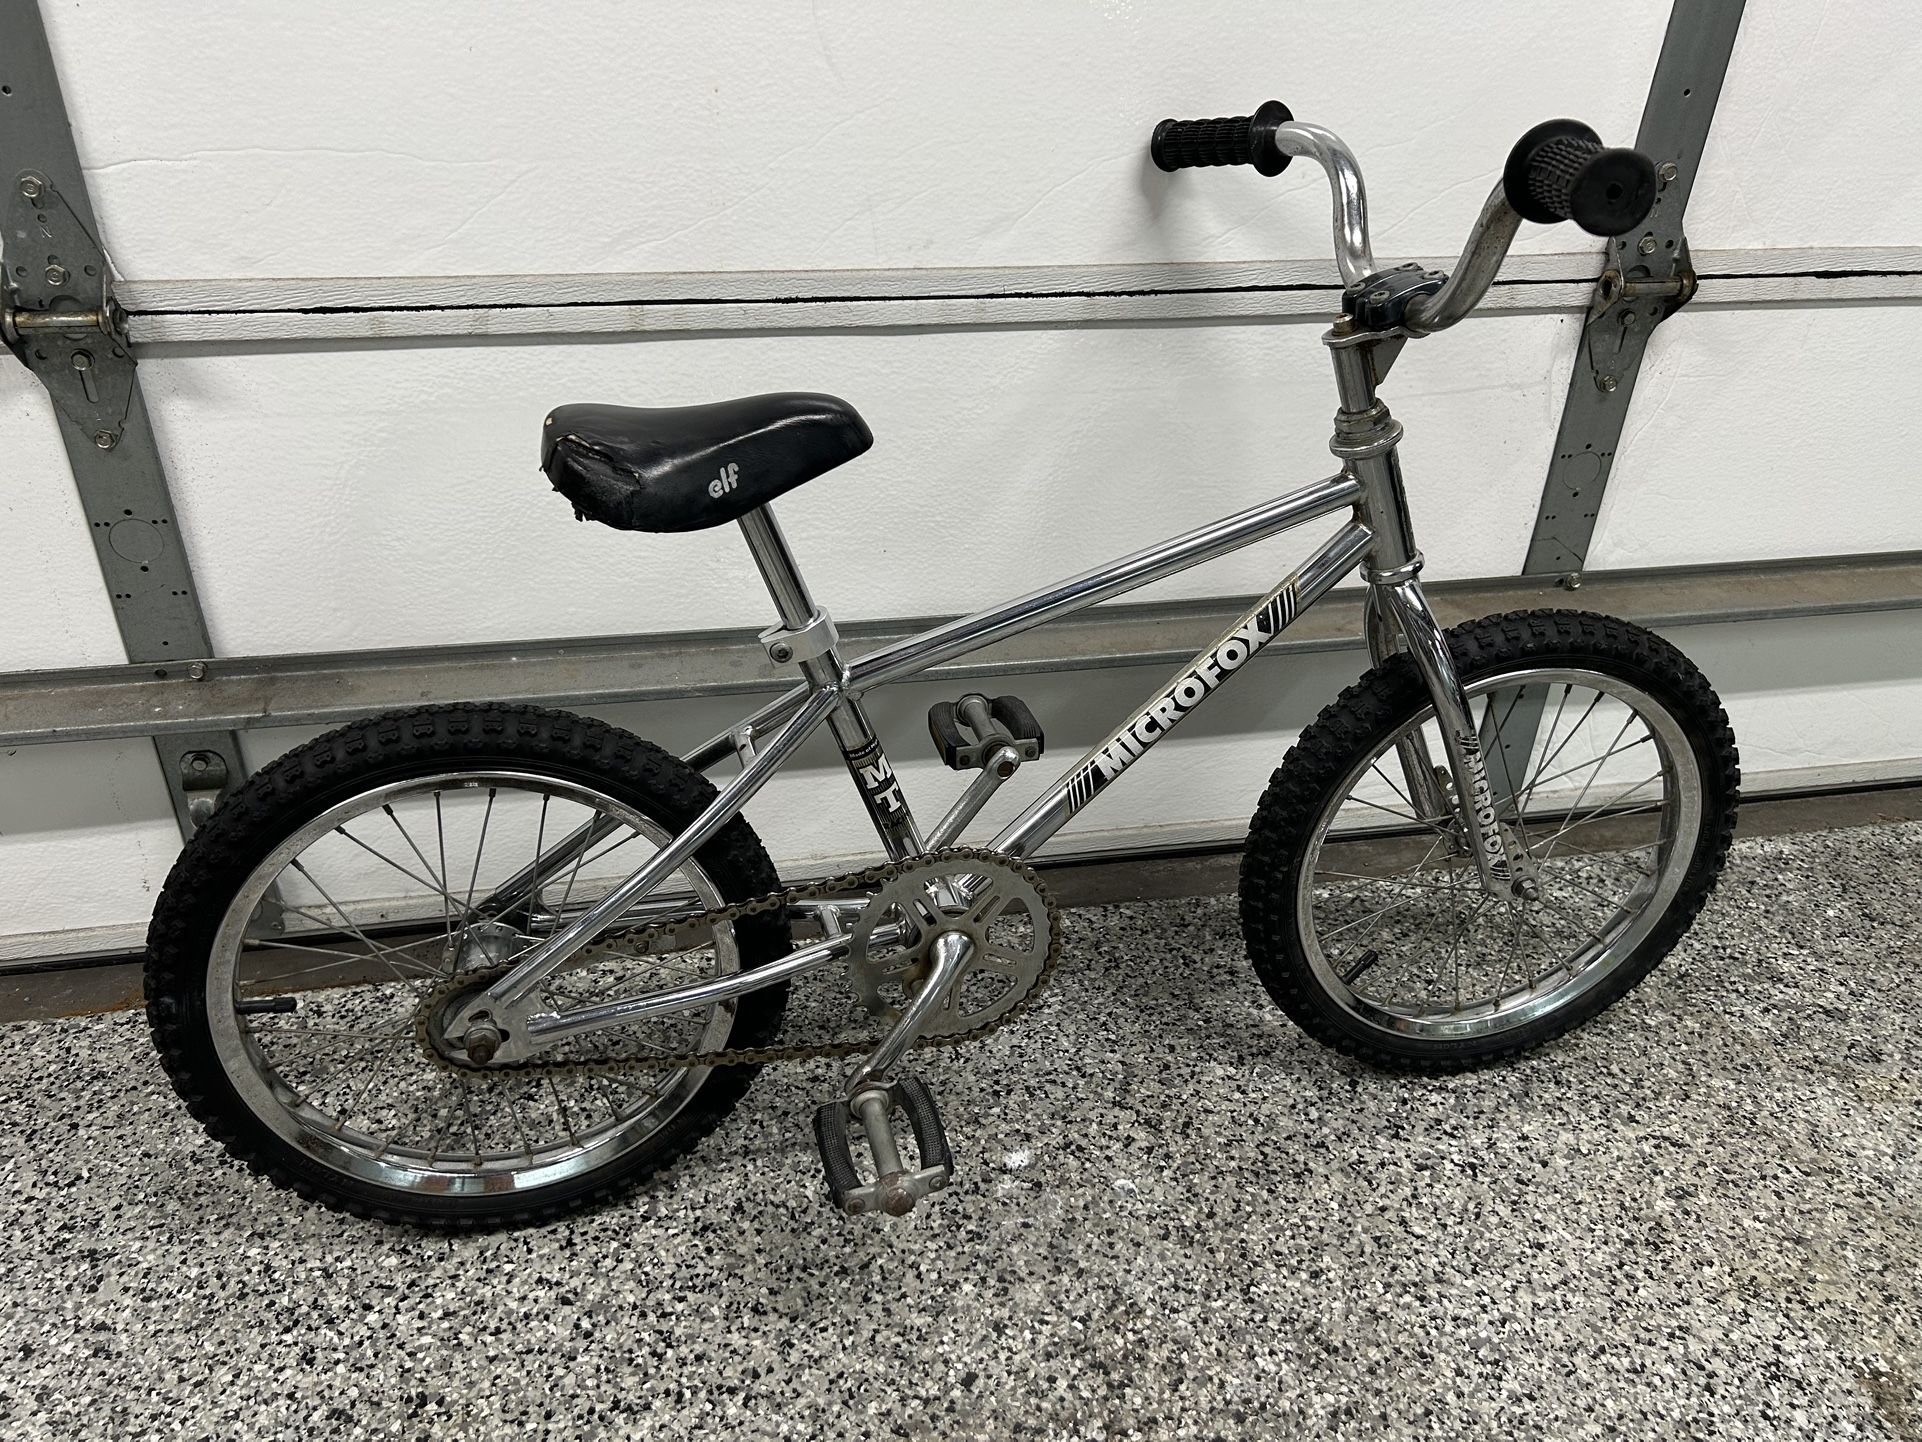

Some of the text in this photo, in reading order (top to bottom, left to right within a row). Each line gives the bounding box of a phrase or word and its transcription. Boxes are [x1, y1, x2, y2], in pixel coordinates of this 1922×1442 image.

[708, 462, 739, 499] elf
[1094, 616, 1273, 781] MICROFOX
[1463, 752, 1509, 867] MICROFOX
